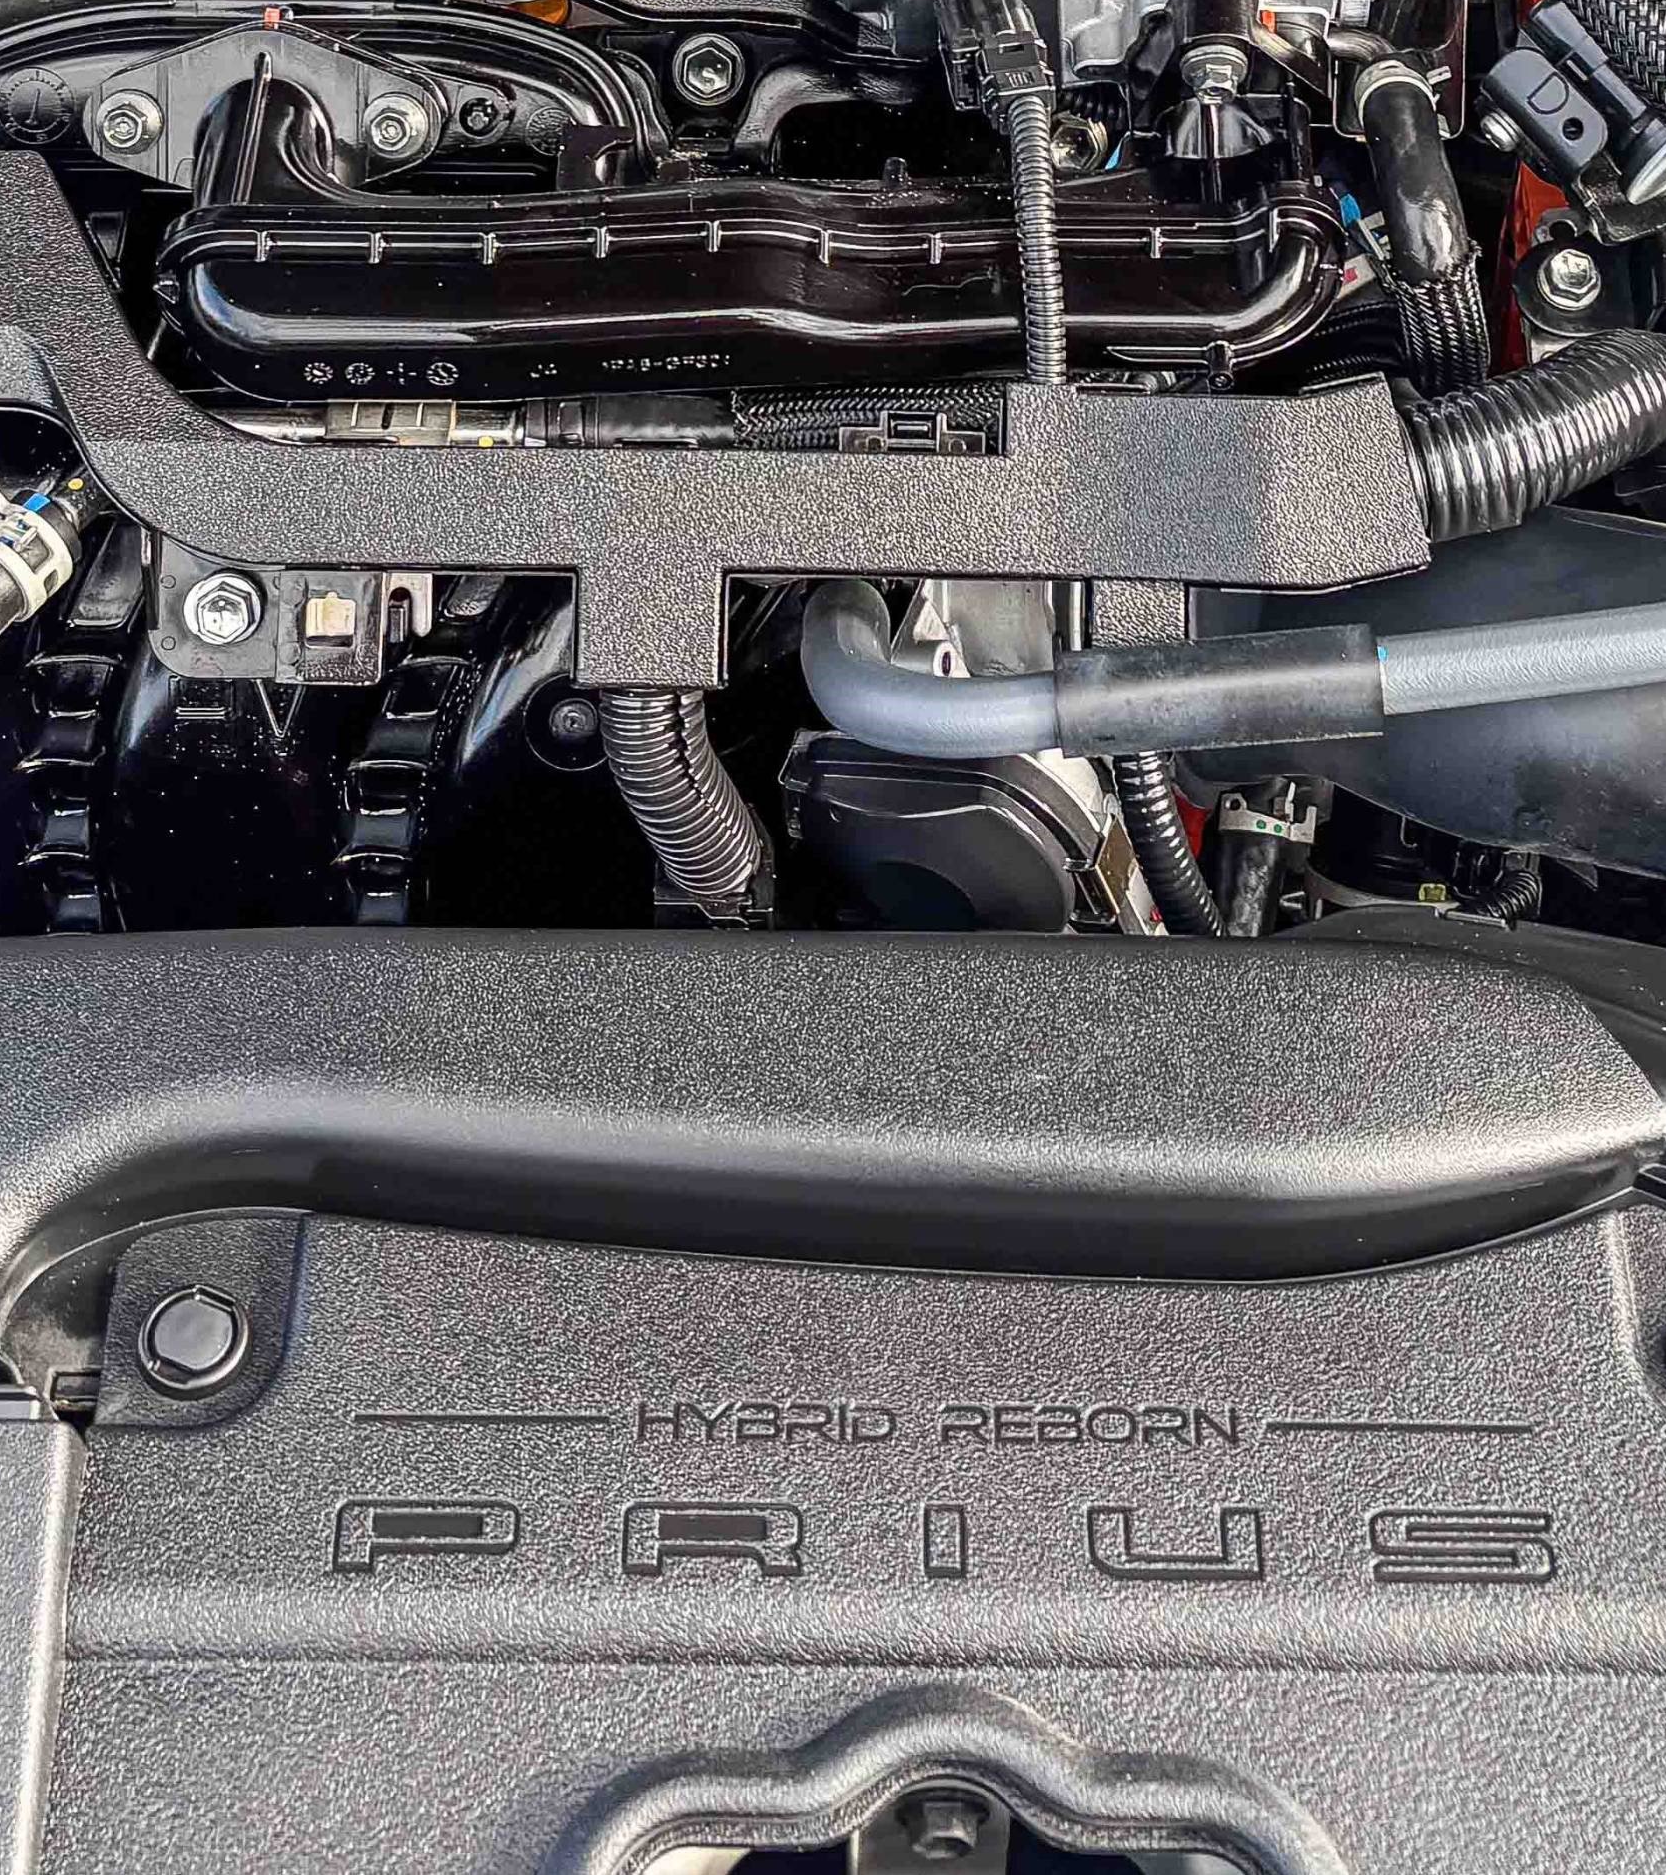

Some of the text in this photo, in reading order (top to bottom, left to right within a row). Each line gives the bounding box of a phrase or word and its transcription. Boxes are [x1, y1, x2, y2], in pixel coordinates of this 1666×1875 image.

[1526, 71, 1570, 115] D
[635, 1401, 1241, 1448] HYBRID REBORN
[332, 1498, 1556, 1582] PRIUS
